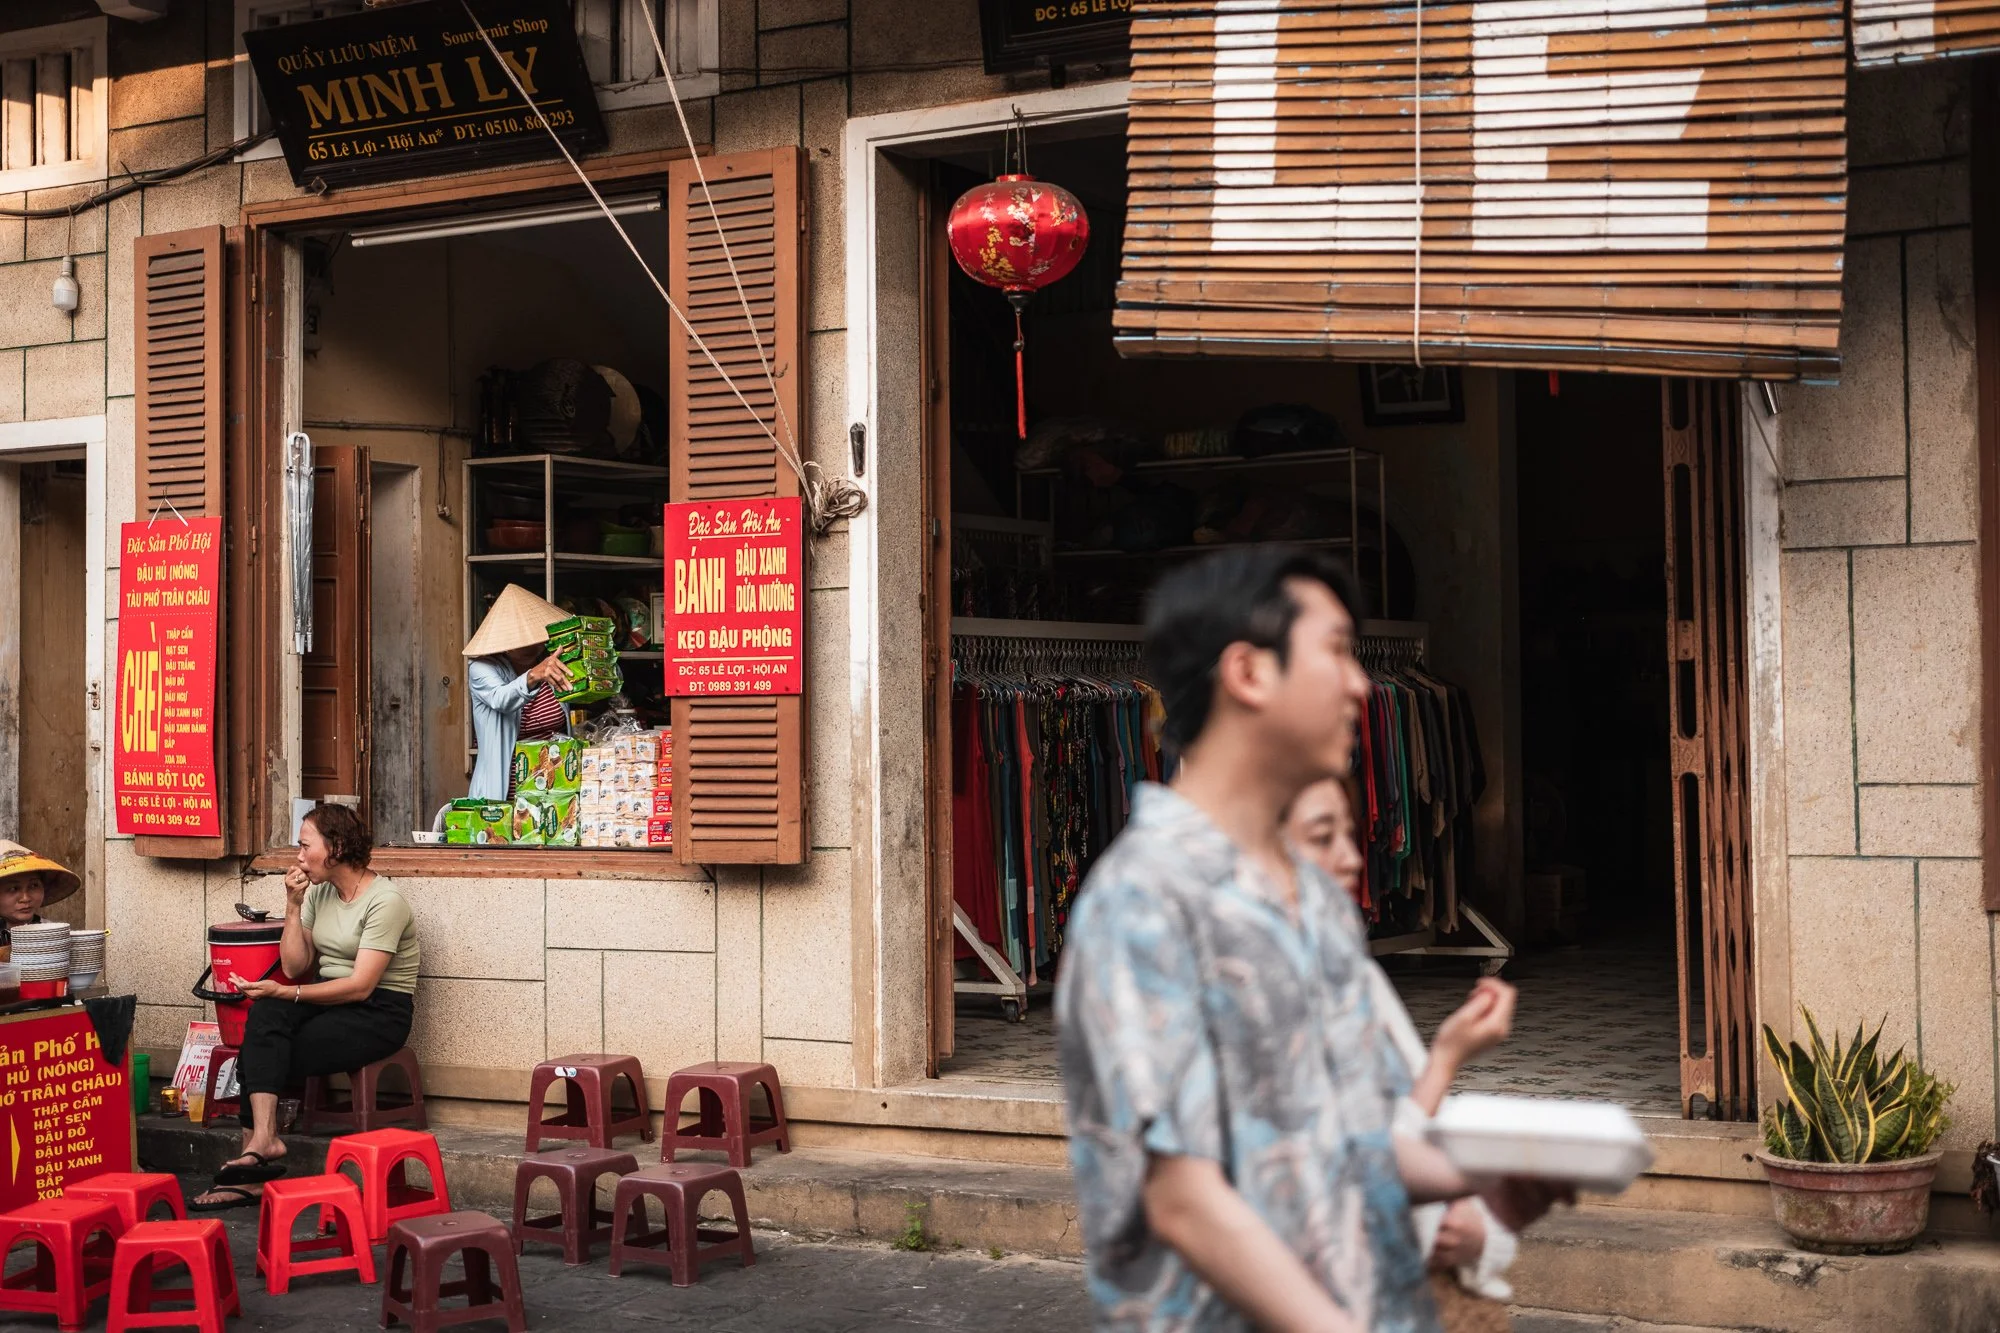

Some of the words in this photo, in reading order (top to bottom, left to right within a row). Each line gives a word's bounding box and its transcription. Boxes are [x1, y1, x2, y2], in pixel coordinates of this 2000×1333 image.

[1035, 5, 1058, 21] ĐC
[1070, 1, 1088, 16] 65
[442, 23, 509, 46] Souvenir
[513, 18, 548, 34] Shop
[278, 45, 326, 75] QUẦY
[329, 42, 366, 64] LƯU
[368, 35, 418, 60] NIỆM
[297, 63, 455, 129] MINH
[465, 46, 539, 102] LY
[452, 122, 482, 140] ĐT:
[309, 141, 328, 160] 65
[330, 142, 349, 158] Lê
[352, 140, 378, 157] Lợi
[387, 133, 415, 151] Hội
[688, 511, 711, 540] Đặc
[714, 510, 737, 534] Sản
[741, 508, 763, 538] Hội
[765, 507, 781, 533] An
[127, 536, 146, 558] Đặc
[147, 532, 166, 553] Sản
[168, 530, 192, 551] Phố
[191, 532, 212, 554] Hội
[137, 562, 153, 584] ĐẬU
[155, 559, 167, 581] HỦ
[169, 560, 199, 581] (NÓNG)
[759, 546, 787, 575] XANH
[674, 546, 726, 614] BÁNH
[126, 588, 142, 608] TÀU
[143, 587, 160, 607] PHỚ
[162, 586, 184, 607] TRÂN
[186, 585, 211, 606] CHÂU
[759, 577, 795, 613] NƯỚNG
[177, 645, 189, 655] SEN
[677, 629, 706, 653] KẸO
[709, 625, 738, 652] ĐẬU
[742, 624, 792, 652] PHỘNG
[679, 665, 696, 676] ĐC:
[698, 665, 710, 675] 65
[712, 663, 725, 675] LÊ
[727, 664, 745, 677] LỢI
[752, 663, 771, 676] HỘI
[772, 664, 787, 675] AN
[689, 681, 705, 692] ĐT:
[708, 681, 731, 692] 0989
[734, 681, 751, 691] 391
[753, 680, 772, 691] 499
[176, 707, 190, 718] XANH
[176, 723, 191, 734] XANH
[123, 768, 154, 786] BÁNH
[157, 768, 178, 789] BỘT
[182, 772, 206, 790] LỌC
[121, 795, 132, 806] ĐC
[138, 796, 149, 807] 65
[150, 795, 160, 808] LÊ
[162, 796, 176, 810] LỢI
[183, 796, 198, 810] HỘI
[200, 798, 213, 809] AN
[133, 812, 143, 823] ĐT
[145, 813, 165, 824] 0914
[167, 814, 182, 825] 309
[184, 815, 201, 826] 422
[0, 1045, 25, 1066] ản
[34, 1032, 79, 1061] Phố
[7, 1065, 30, 1085] HỦ
[37, 1058, 94, 1081] (NÓNG)
[21, 1083, 66, 1103] TRÂN
[71, 1072, 122, 1093] CHÂU)
[32, 1102, 69, 1117] THẬP
[73, 1093, 102, 1110] CẨM
[34, 1117, 60, 1131] HẠT
[65, 1111, 91, 1125] SEN
[35, 1130, 63, 1145] ĐẬU
[67, 1123, 86, 1138] ĐỎ
[35, 1145, 63, 1159] ĐẬU
[67, 1137, 95, 1153] NGỰ
[35, 1161, 63, 1176] ĐẬU
[67, 1154, 102, 1169] XANH
[38, 1187, 64, 1201] XOA
